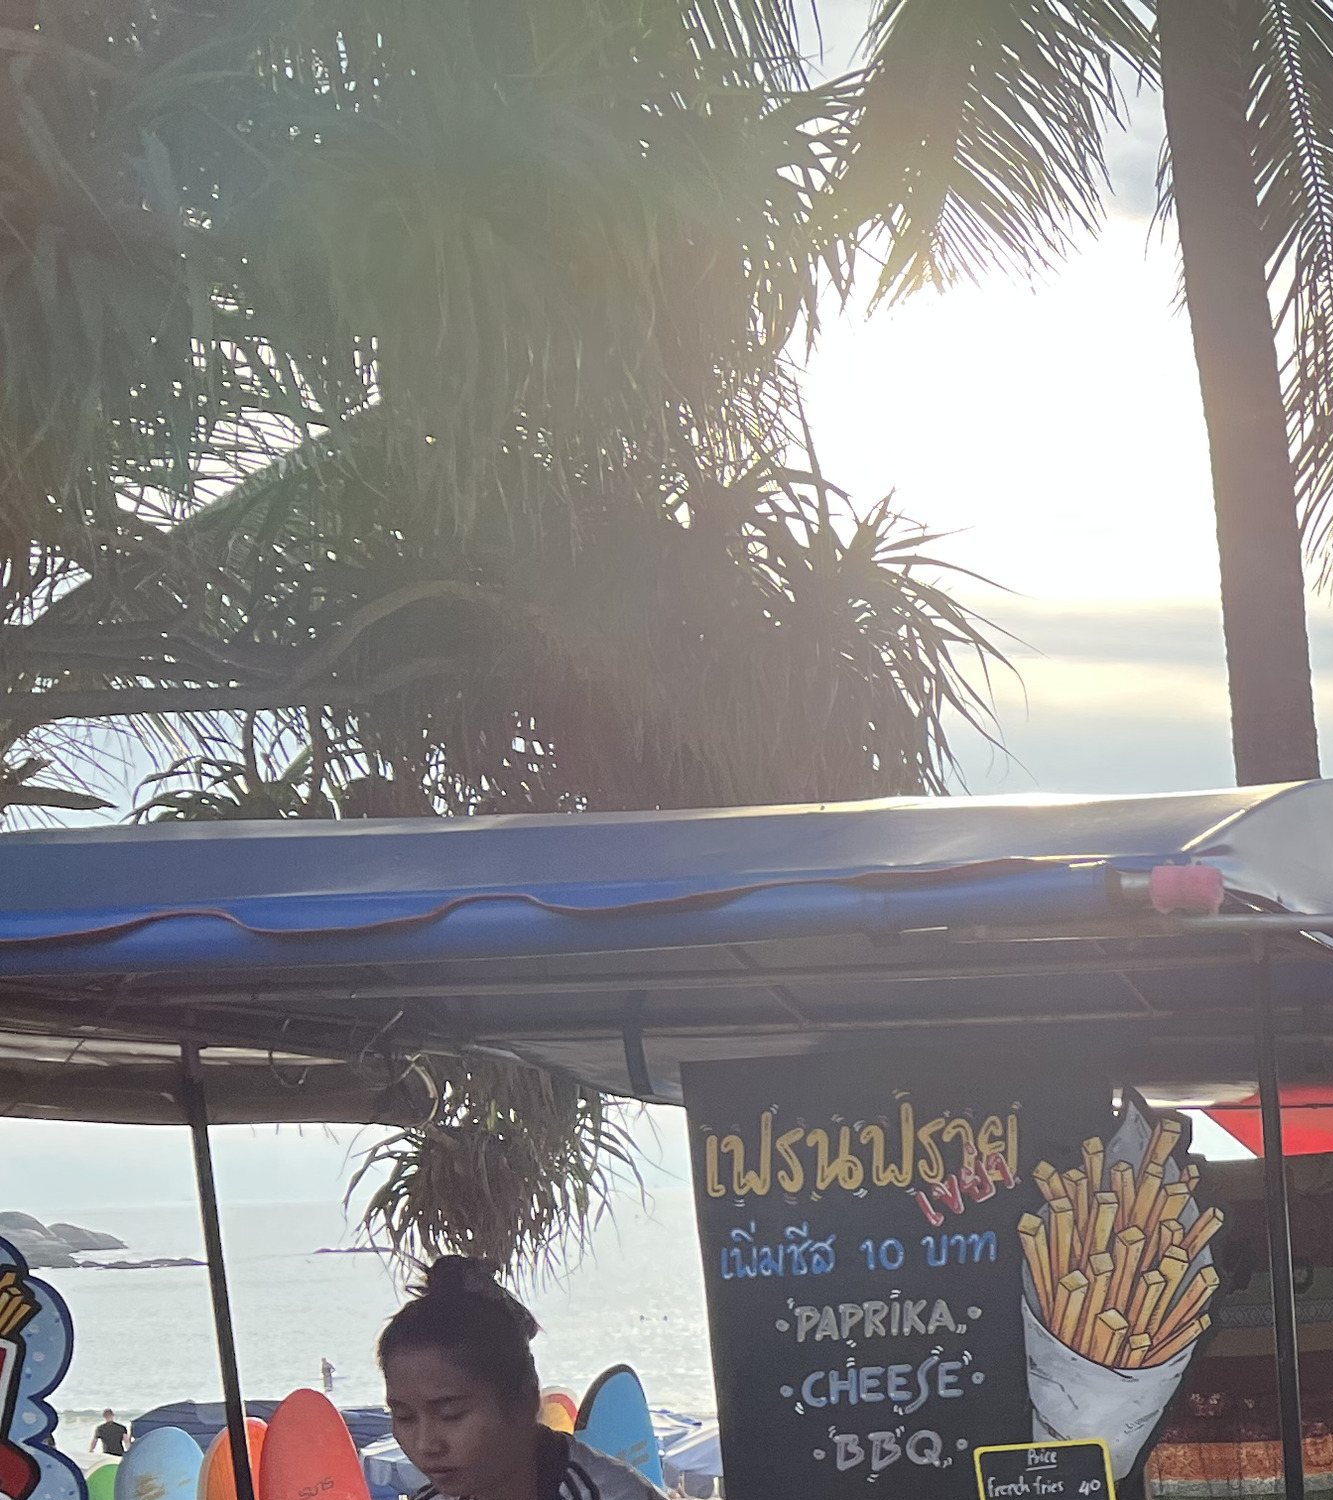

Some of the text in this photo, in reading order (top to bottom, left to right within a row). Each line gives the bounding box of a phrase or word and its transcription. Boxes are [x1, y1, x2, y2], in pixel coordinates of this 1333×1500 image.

[860, 1237, 905, 1270] 10
[922, 1231, 997, 1268] บาท
[795, 1299, 956, 1342] PAPRIKA
[801, 1355, 964, 1414] CHEESE
[833, 1429, 943, 1471] BBQ
[1027, 1449, 1057, 1466] Price
[1078, 1480, 1101, 1495] 40
